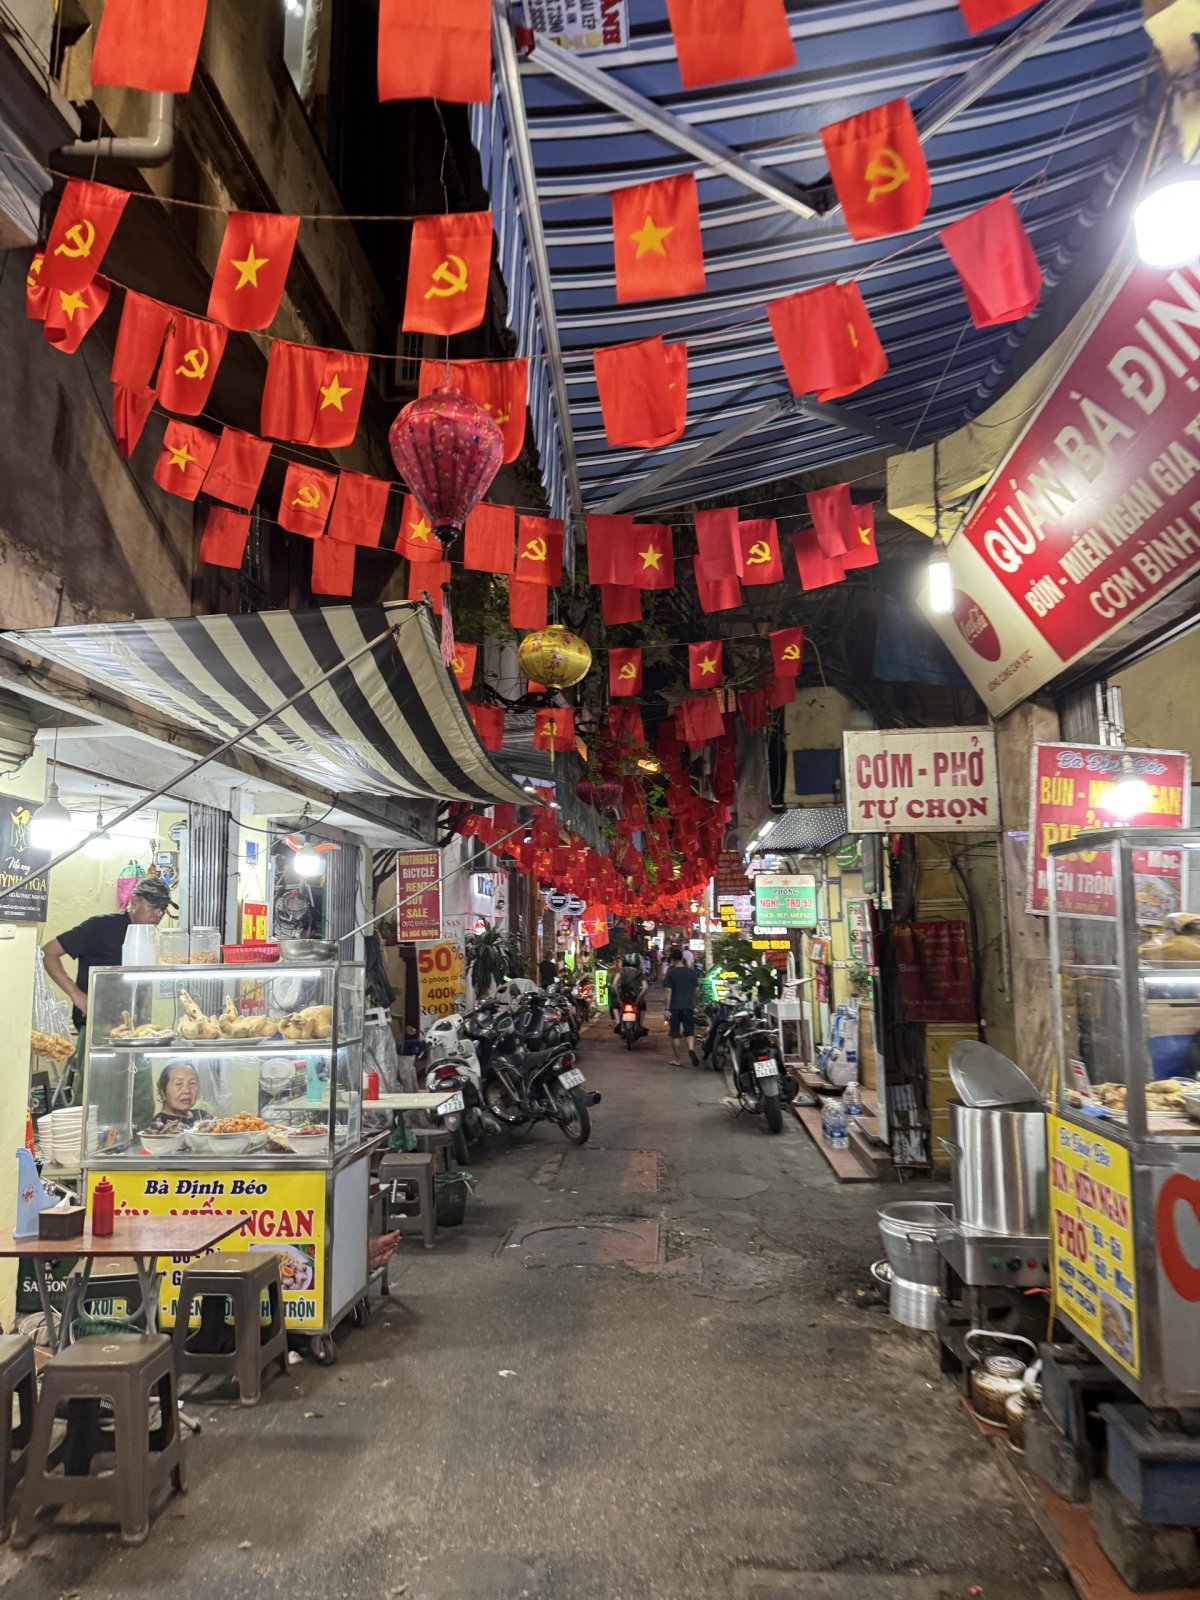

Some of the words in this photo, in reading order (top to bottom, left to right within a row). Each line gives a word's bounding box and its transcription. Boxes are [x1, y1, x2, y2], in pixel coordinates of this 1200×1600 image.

[984, 458, 1080, 573] QUÁN
[1054, 391, 1136, 484] BÀ
[1024, 574, 1066, 617] BÚN
[1058, 528, 1114, 584] MIẾN
[1098, 478, 1164, 547] NGAN
[1149, 441, 1200, 496] GIA
[1090, 563, 1146, 618] CƠM
[1131, 517, 1200, 583] BÌNH
[856, 750, 914, 789] CƠM
[933, 736, 985, 787] PHỞ
[1040, 771, 1075, 806] BÚN
[858, 796, 899, 825] TỰ
[906, 797, 988, 825] CHỌN
[403, 867, 435, 879] BICYCLE
[406, 881, 439, 892] RENTAL
[1038, 866, 1074, 892] MẾN
[406, 907, 429, 918] SALE
[419, 946, 464, 974] 50%
[144, 1180, 169, 1195] Bà
[175, 1179, 224, 1199] Định
[231, 1179, 267, 1195] Béo
[239, 1209, 315, 1238] NGAN
[23, 1280, 67, 1292] SAGON
